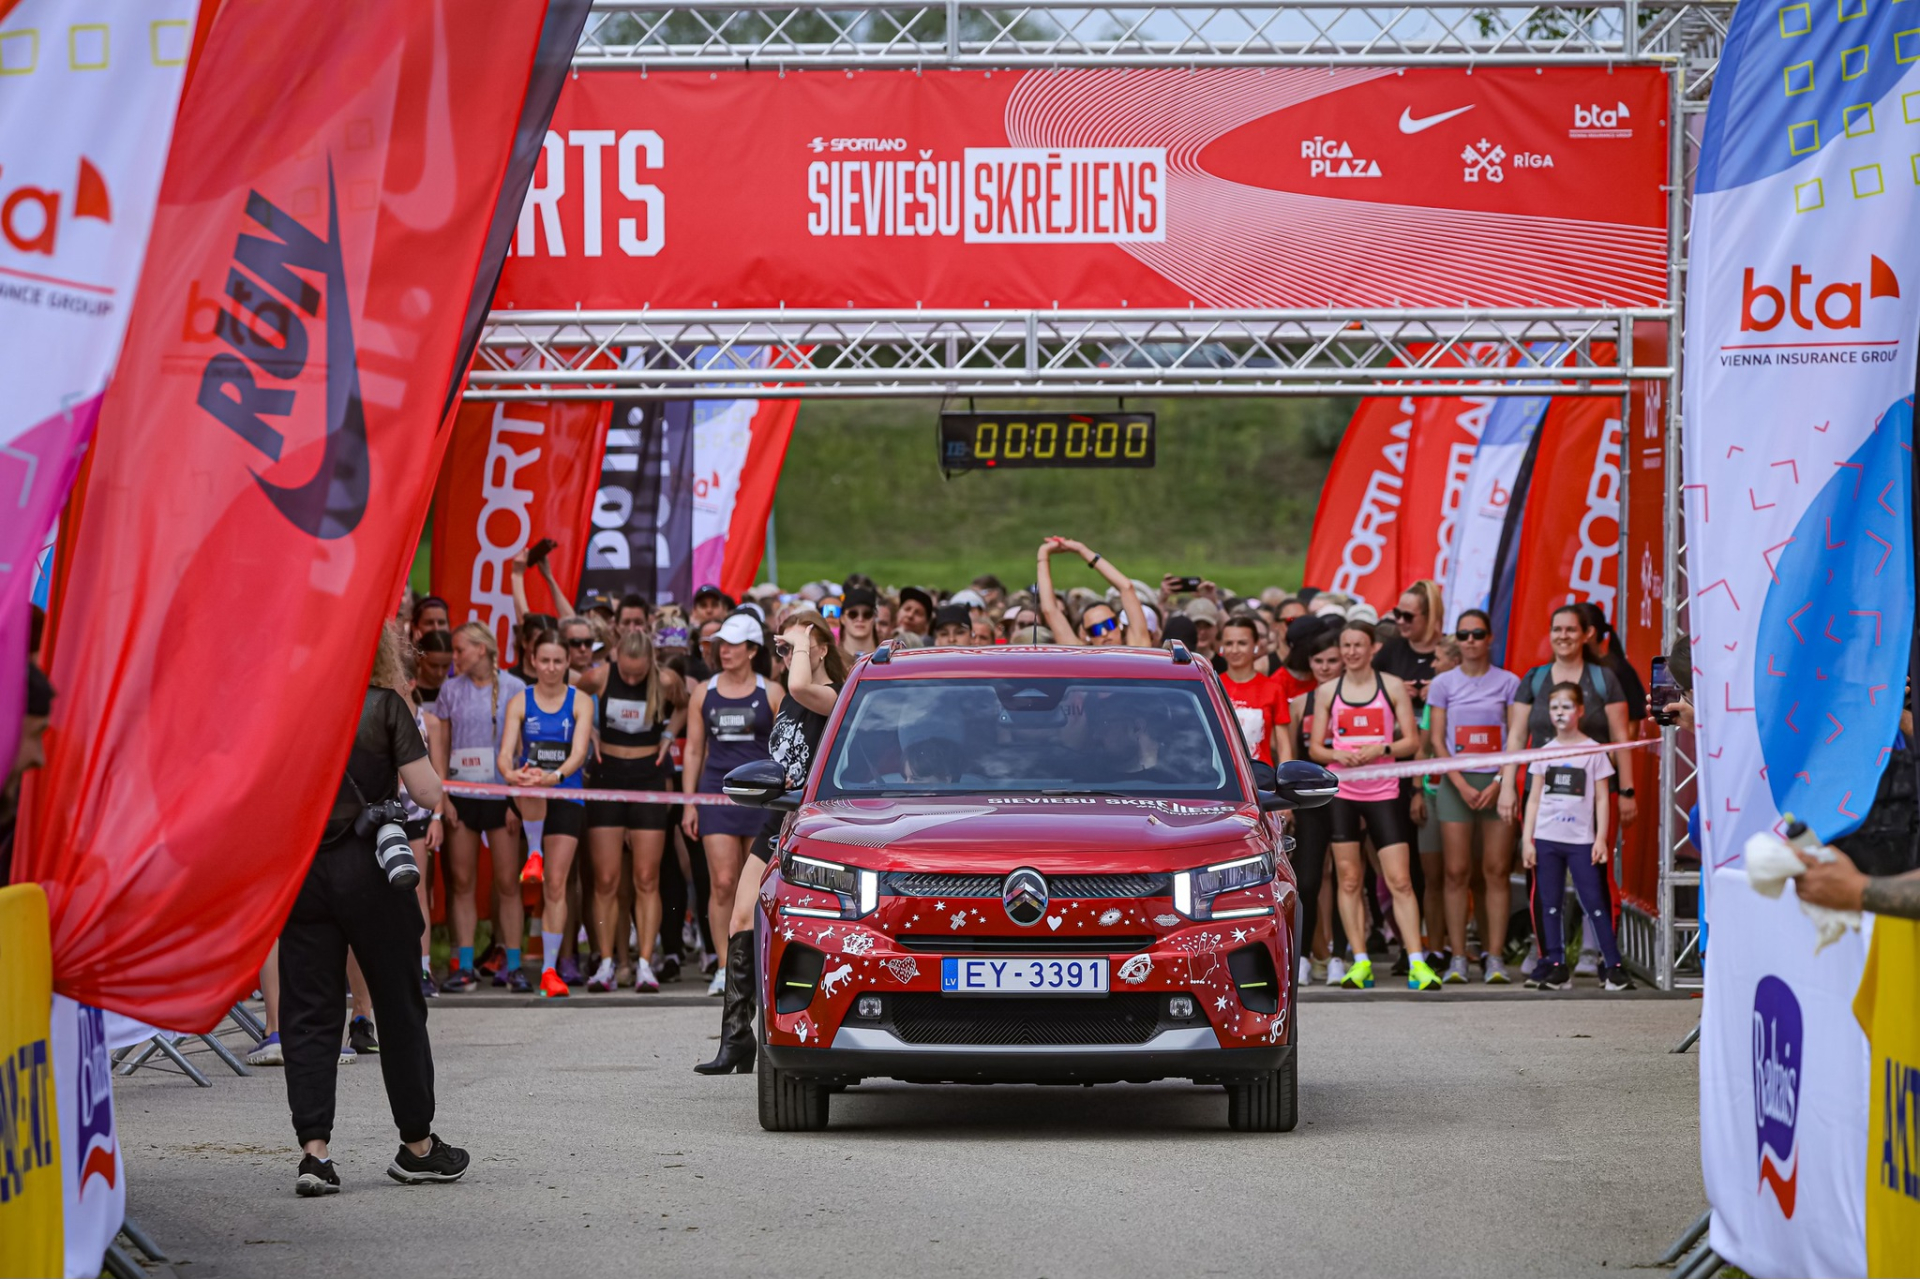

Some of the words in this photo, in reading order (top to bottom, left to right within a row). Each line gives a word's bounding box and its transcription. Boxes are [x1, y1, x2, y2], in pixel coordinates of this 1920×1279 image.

[1575, 104, 1617, 127] bta
[831, 138, 906, 151] SPORTLAND
[1301, 136, 1353, 158] RĪGA
[1311, 159, 1382, 177] PLAZA
[1513, 152, 1554, 168] RĪGA
[807, 150, 960, 236] SIEVIEŠU
[975, 154, 1156, 234] SKRĒJIENS
[1740, 264, 1861, 332] bta
[1720, 353, 1772, 367] VIENNA
[1776, 351, 1857, 365] INSURANCE
[945, 977, 957, 987] LV
[966, 959, 1101, 989] EY-3391
